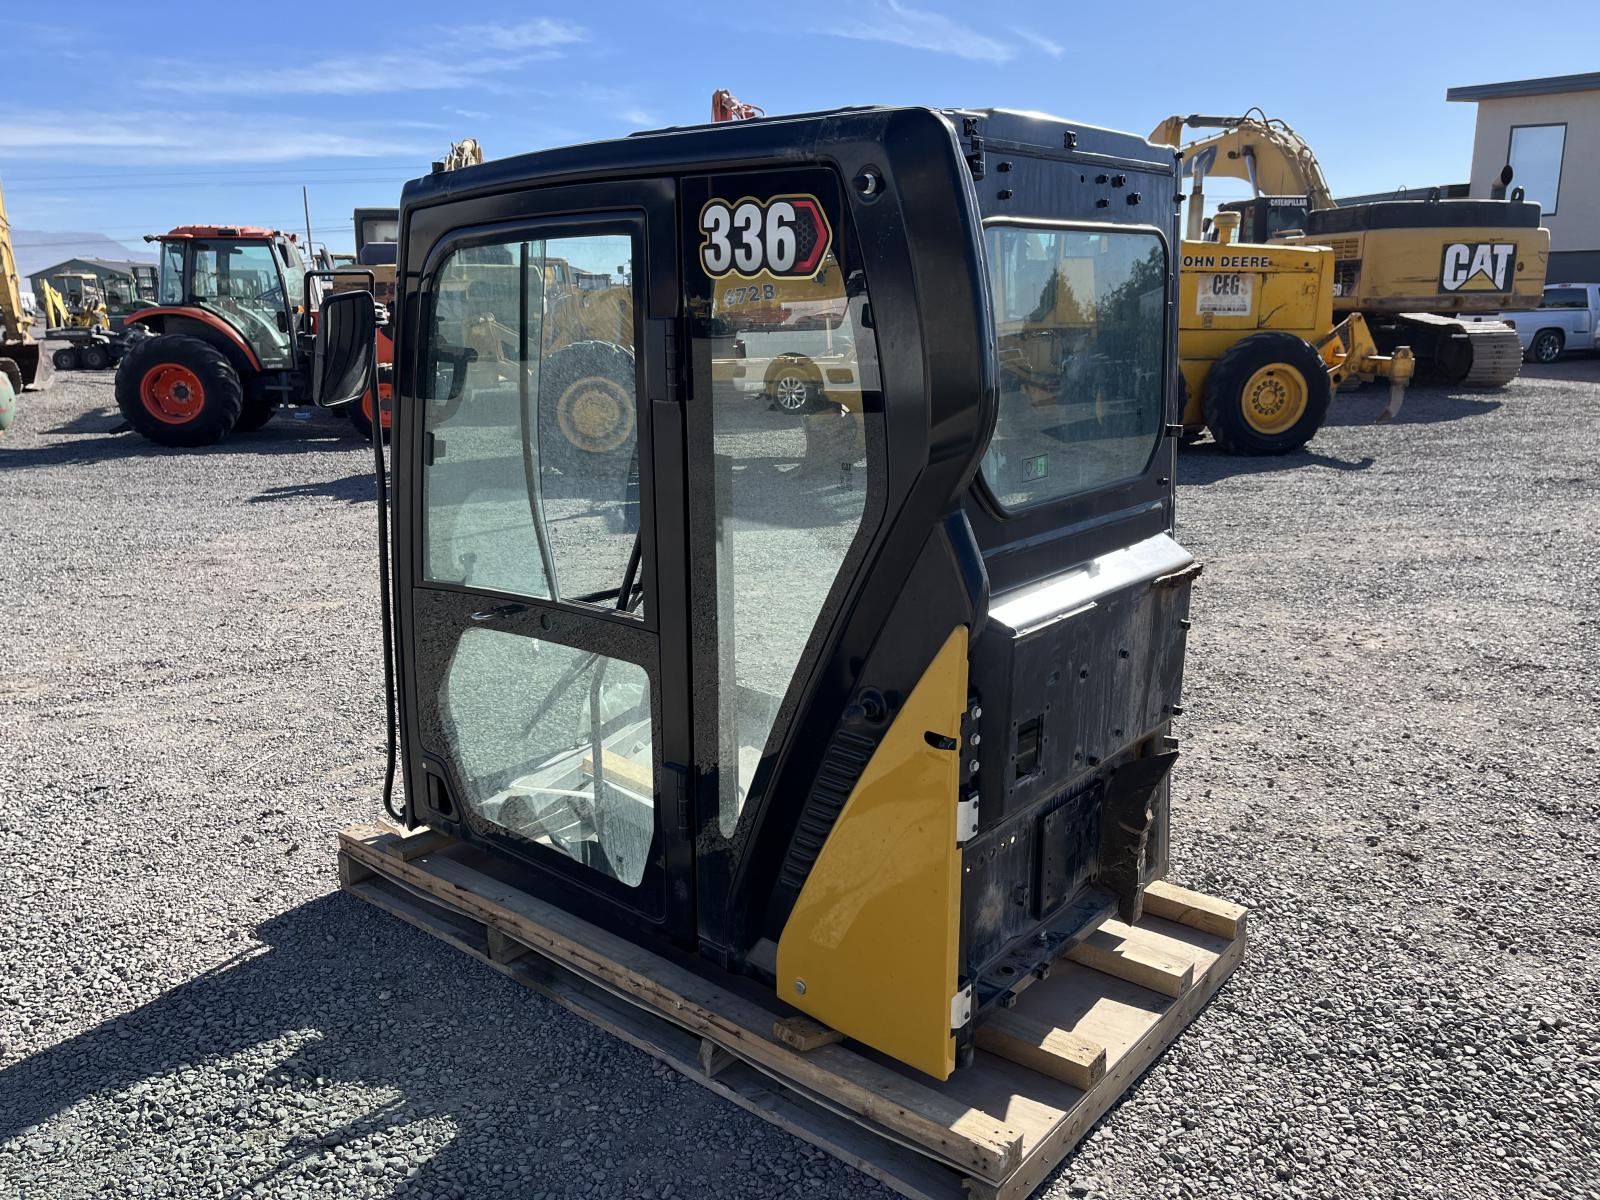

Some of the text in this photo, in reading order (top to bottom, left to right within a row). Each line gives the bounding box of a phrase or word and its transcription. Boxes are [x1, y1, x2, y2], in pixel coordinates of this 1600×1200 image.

[1270, 198, 1308, 207] CATERPILLAR
[702, 201, 797, 273] 336
[1180, 255, 1269, 268] OHN DEERE
[1442, 243, 1514, 291] CAT
[1212, 274, 1241, 296] CEG
